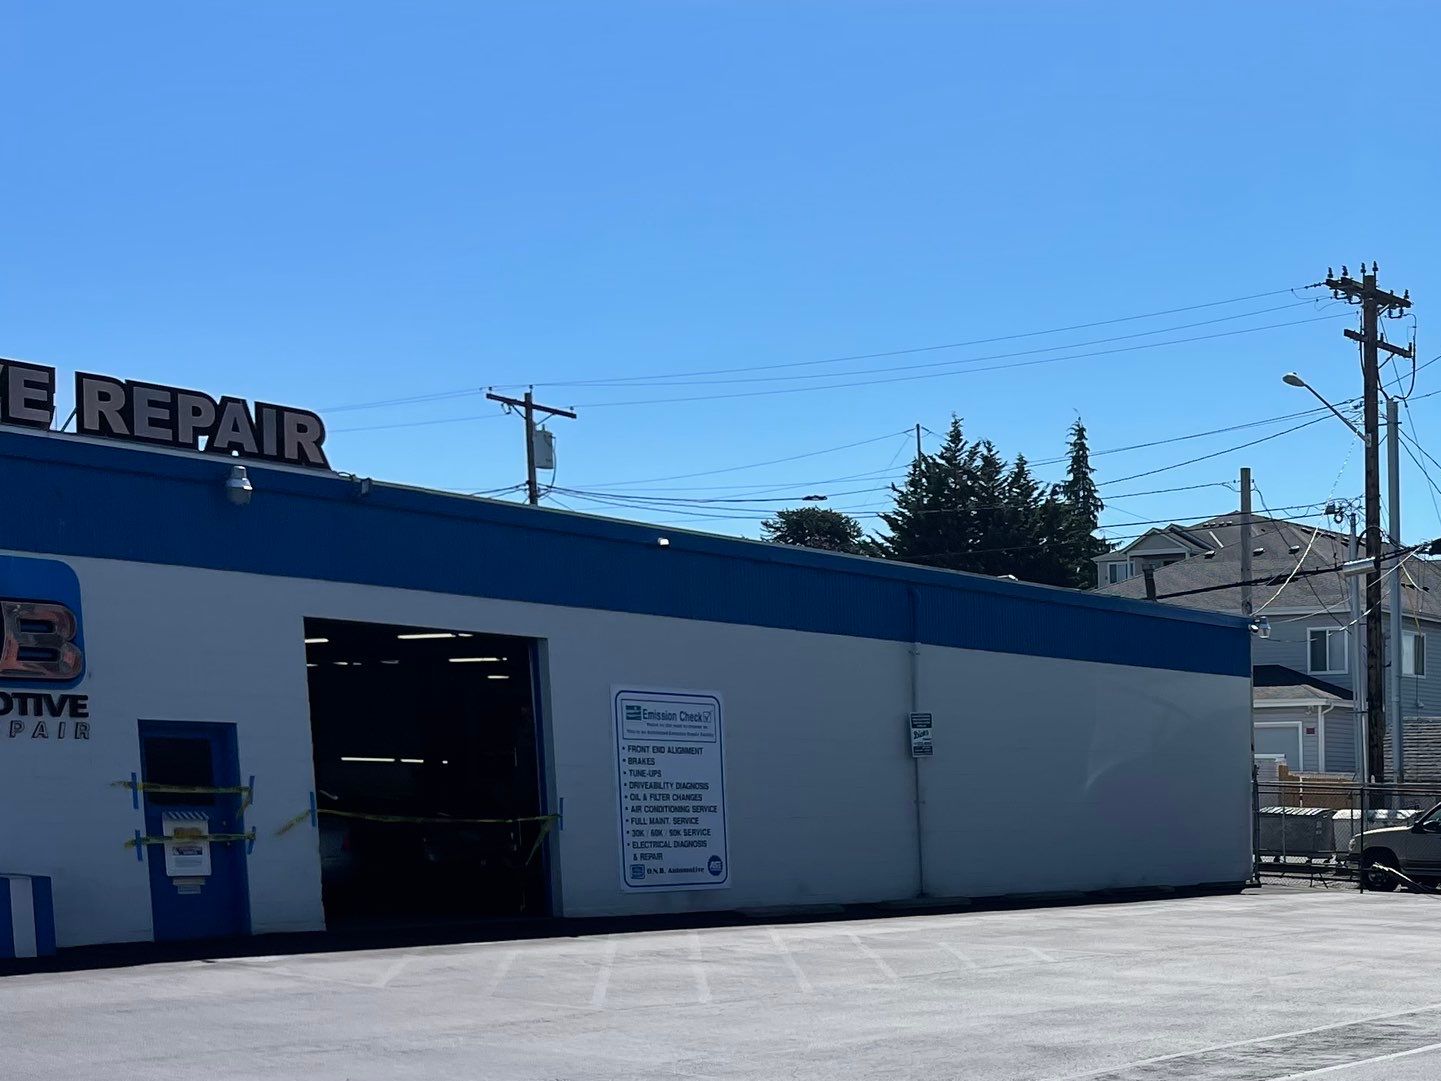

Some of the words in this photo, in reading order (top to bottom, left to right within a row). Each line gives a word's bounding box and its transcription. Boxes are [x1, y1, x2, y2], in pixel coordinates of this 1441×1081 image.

[80, 374, 327, 467] REPAIR
[642, 708, 678, 721] Emission
[679, 710, 702, 723] Check
[627, 744, 650, 754] FRONT
[652, 745, 666, 754] END
[667, 746, 704, 756] ALIGNMENT
[627, 757, 655, 766] BRAKES
[629, 769, 662, 778] TUNE-UPS
[629, 781, 674, 790] DRIVEABILITY
[675, 782, 710, 790] DIAGNOSIS
[629, 793, 641, 802] OIL
[649, 793, 671, 802] FILTER
[672, 793, 703, 802] CHANGES
[630, 805, 643, 813] AIR
[643, 805, 691, 813] CONDITIONING
[692, 805, 718, 813] SERVICE
[630, 817, 648, 825] FULL
[672, 817, 700, 825] SERVICE
[683, 828, 712, 837] SERVICE
[632, 841, 673, 849] ELECTRICAL
[673, 840, 708, 848] DIAGNOSIS
[640, 852, 663, 861] REPAIR
[667, 866, 705, 874] Automotive
